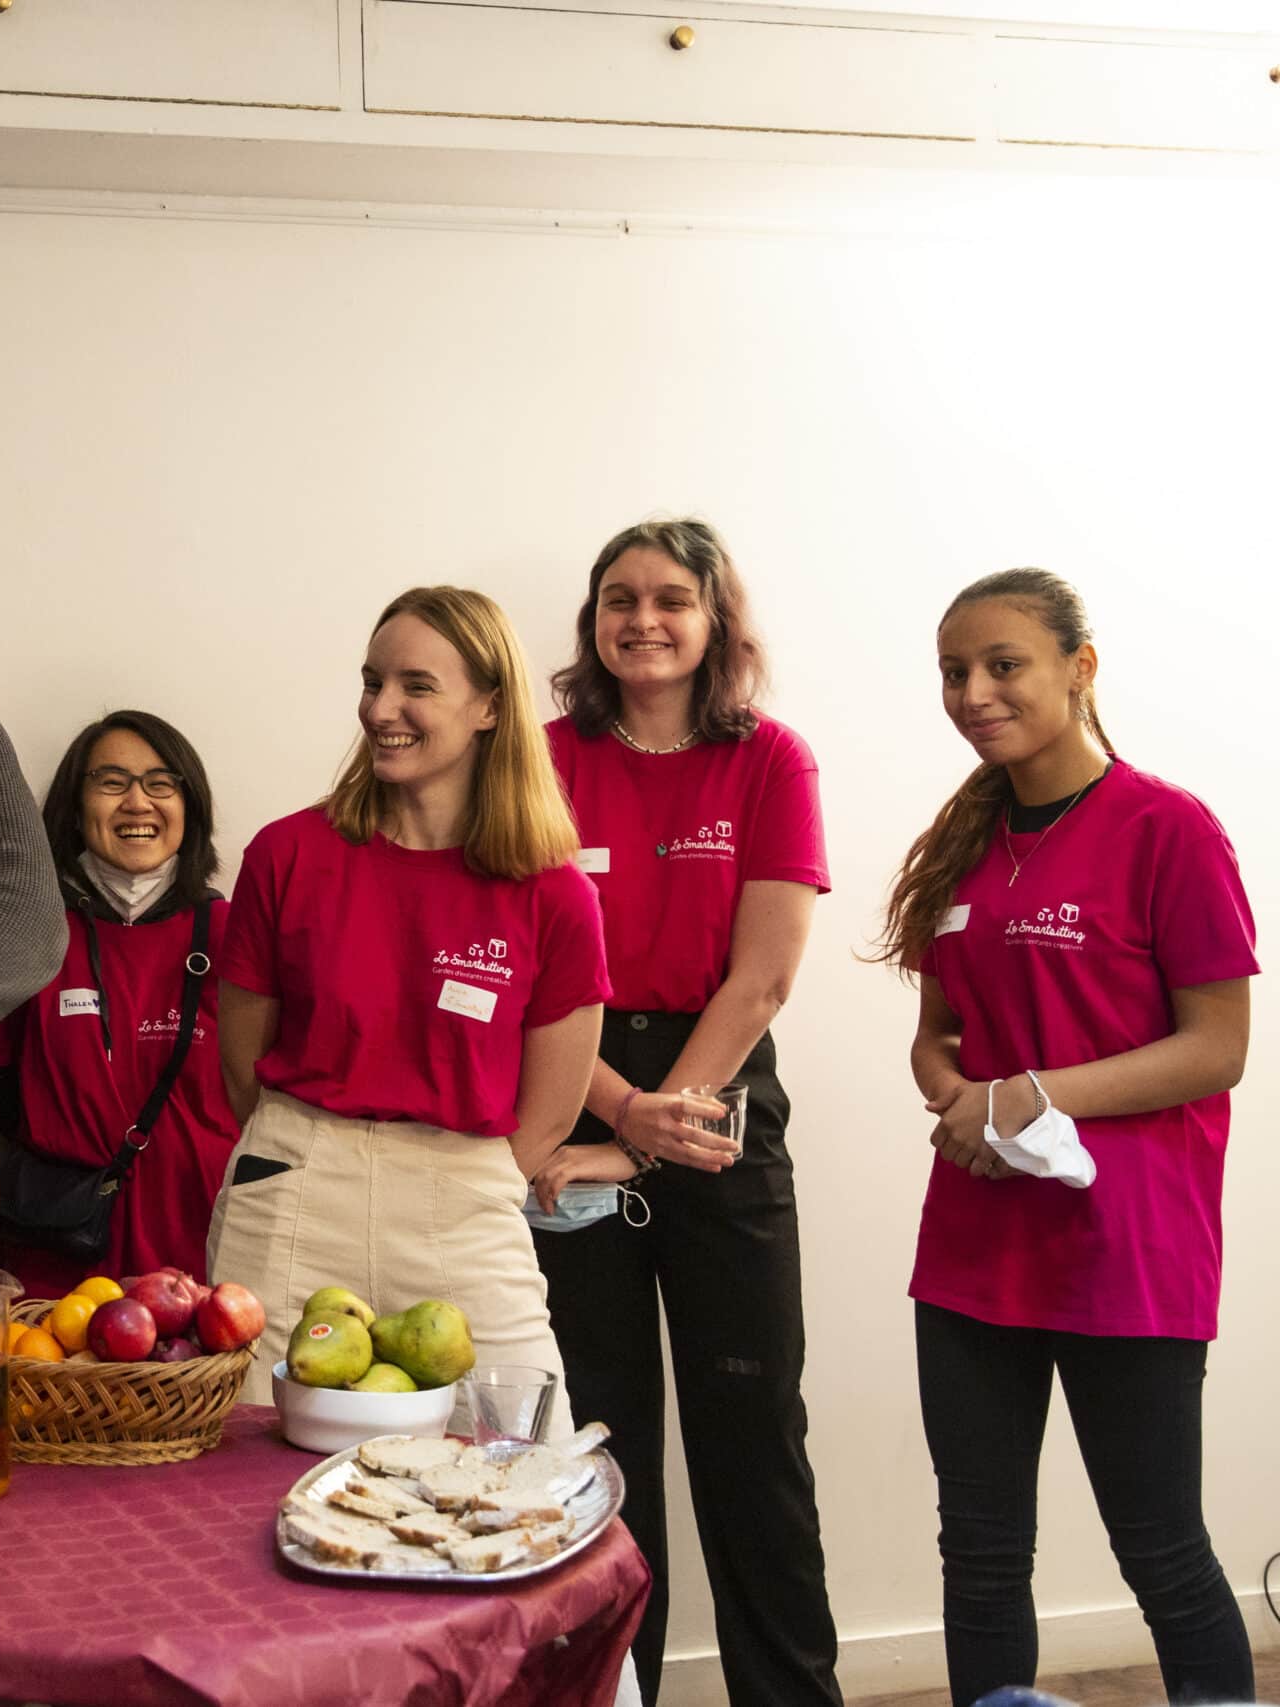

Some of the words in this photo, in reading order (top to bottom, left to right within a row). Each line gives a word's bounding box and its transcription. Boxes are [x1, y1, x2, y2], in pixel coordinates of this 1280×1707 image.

[1018, 919, 1086, 944] Smartsitting
[433, 950, 449, 965] Le
[450, 953, 513, 979] Smartsitting
